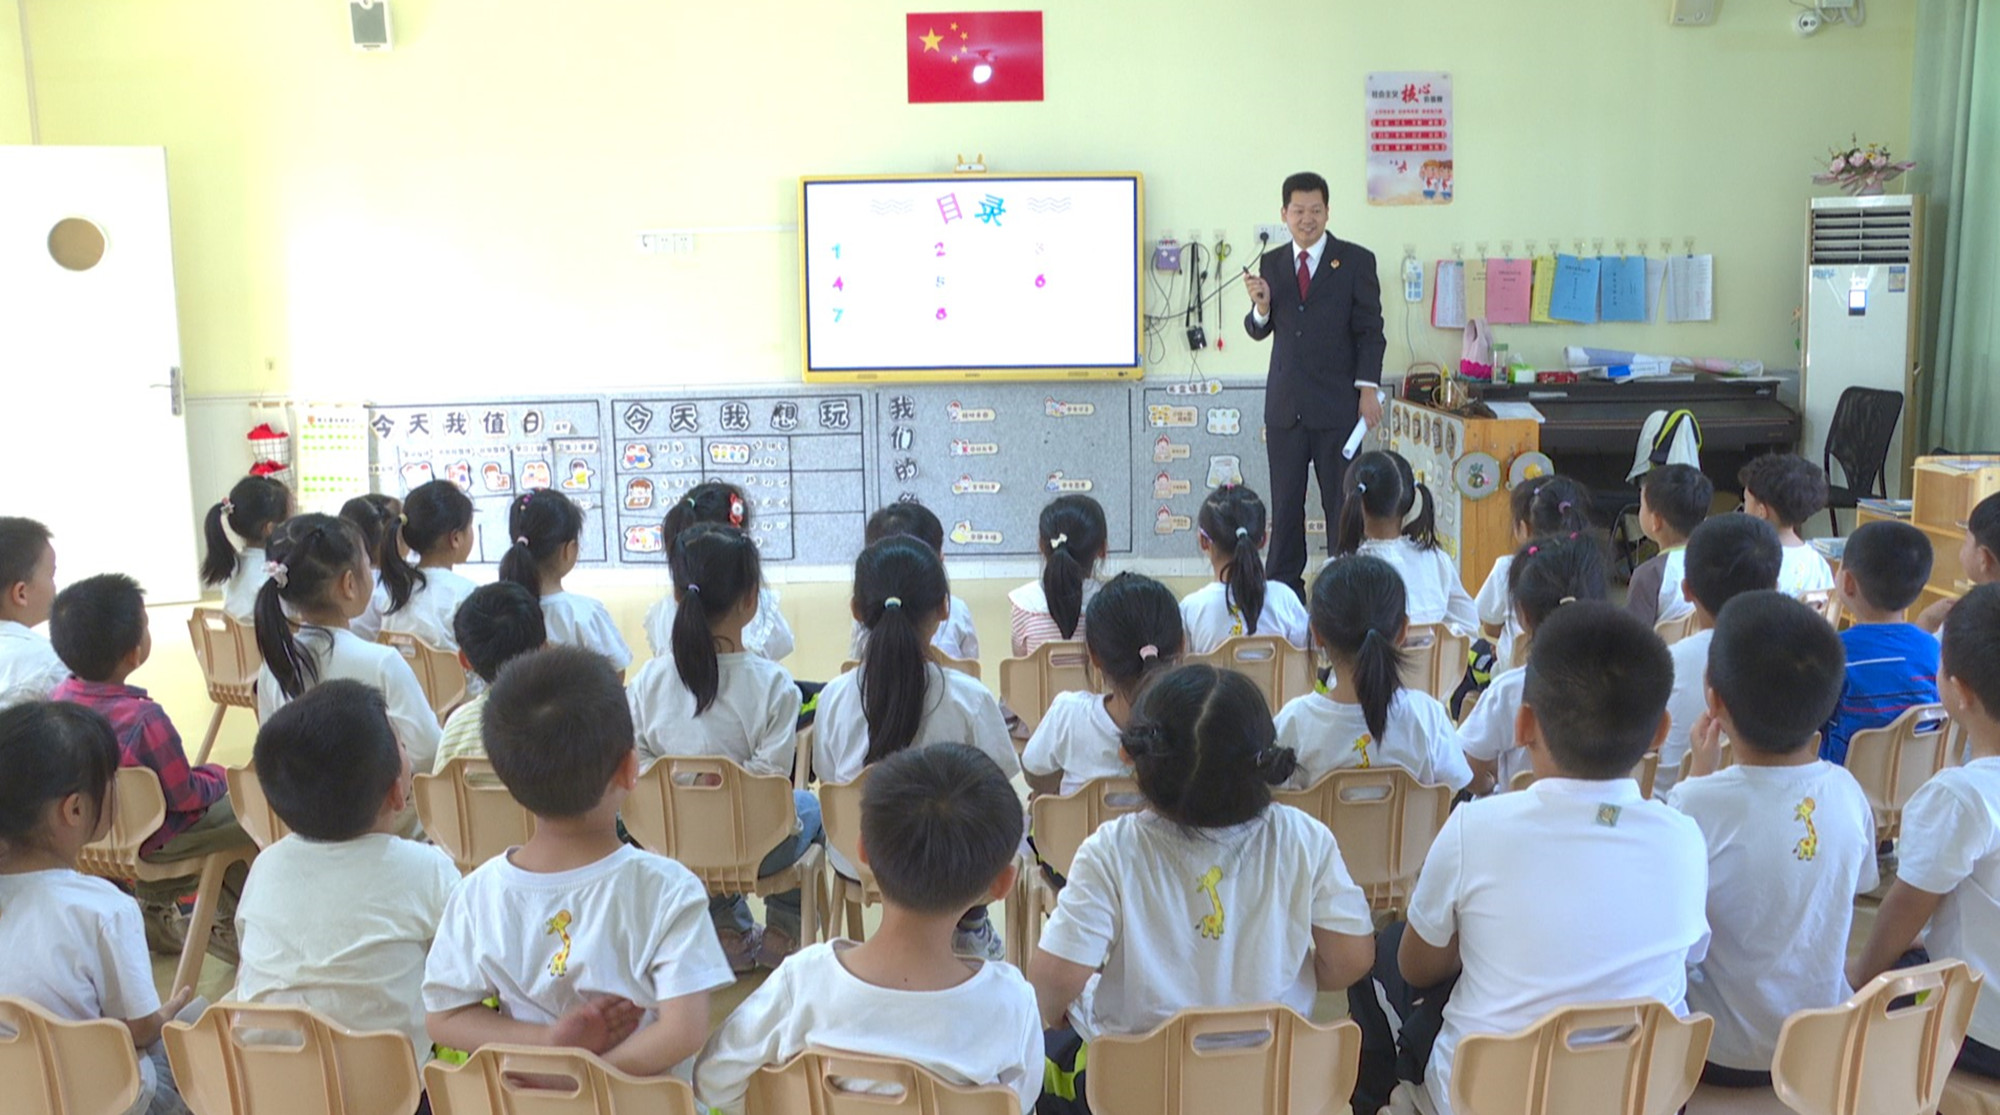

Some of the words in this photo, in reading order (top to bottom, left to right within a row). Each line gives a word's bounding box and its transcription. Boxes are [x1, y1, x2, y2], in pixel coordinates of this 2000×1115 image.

[936, 192, 1006, 227] 目录
[831, 242, 841, 260] 1
[934, 241, 946, 257] 2
[1034, 273, 1046, 289] 6
[832, 307, 844, 323] 7
[372, 411, 540, 438] 今天我值日
[625, 401, 848, 433] 今天我想玩
